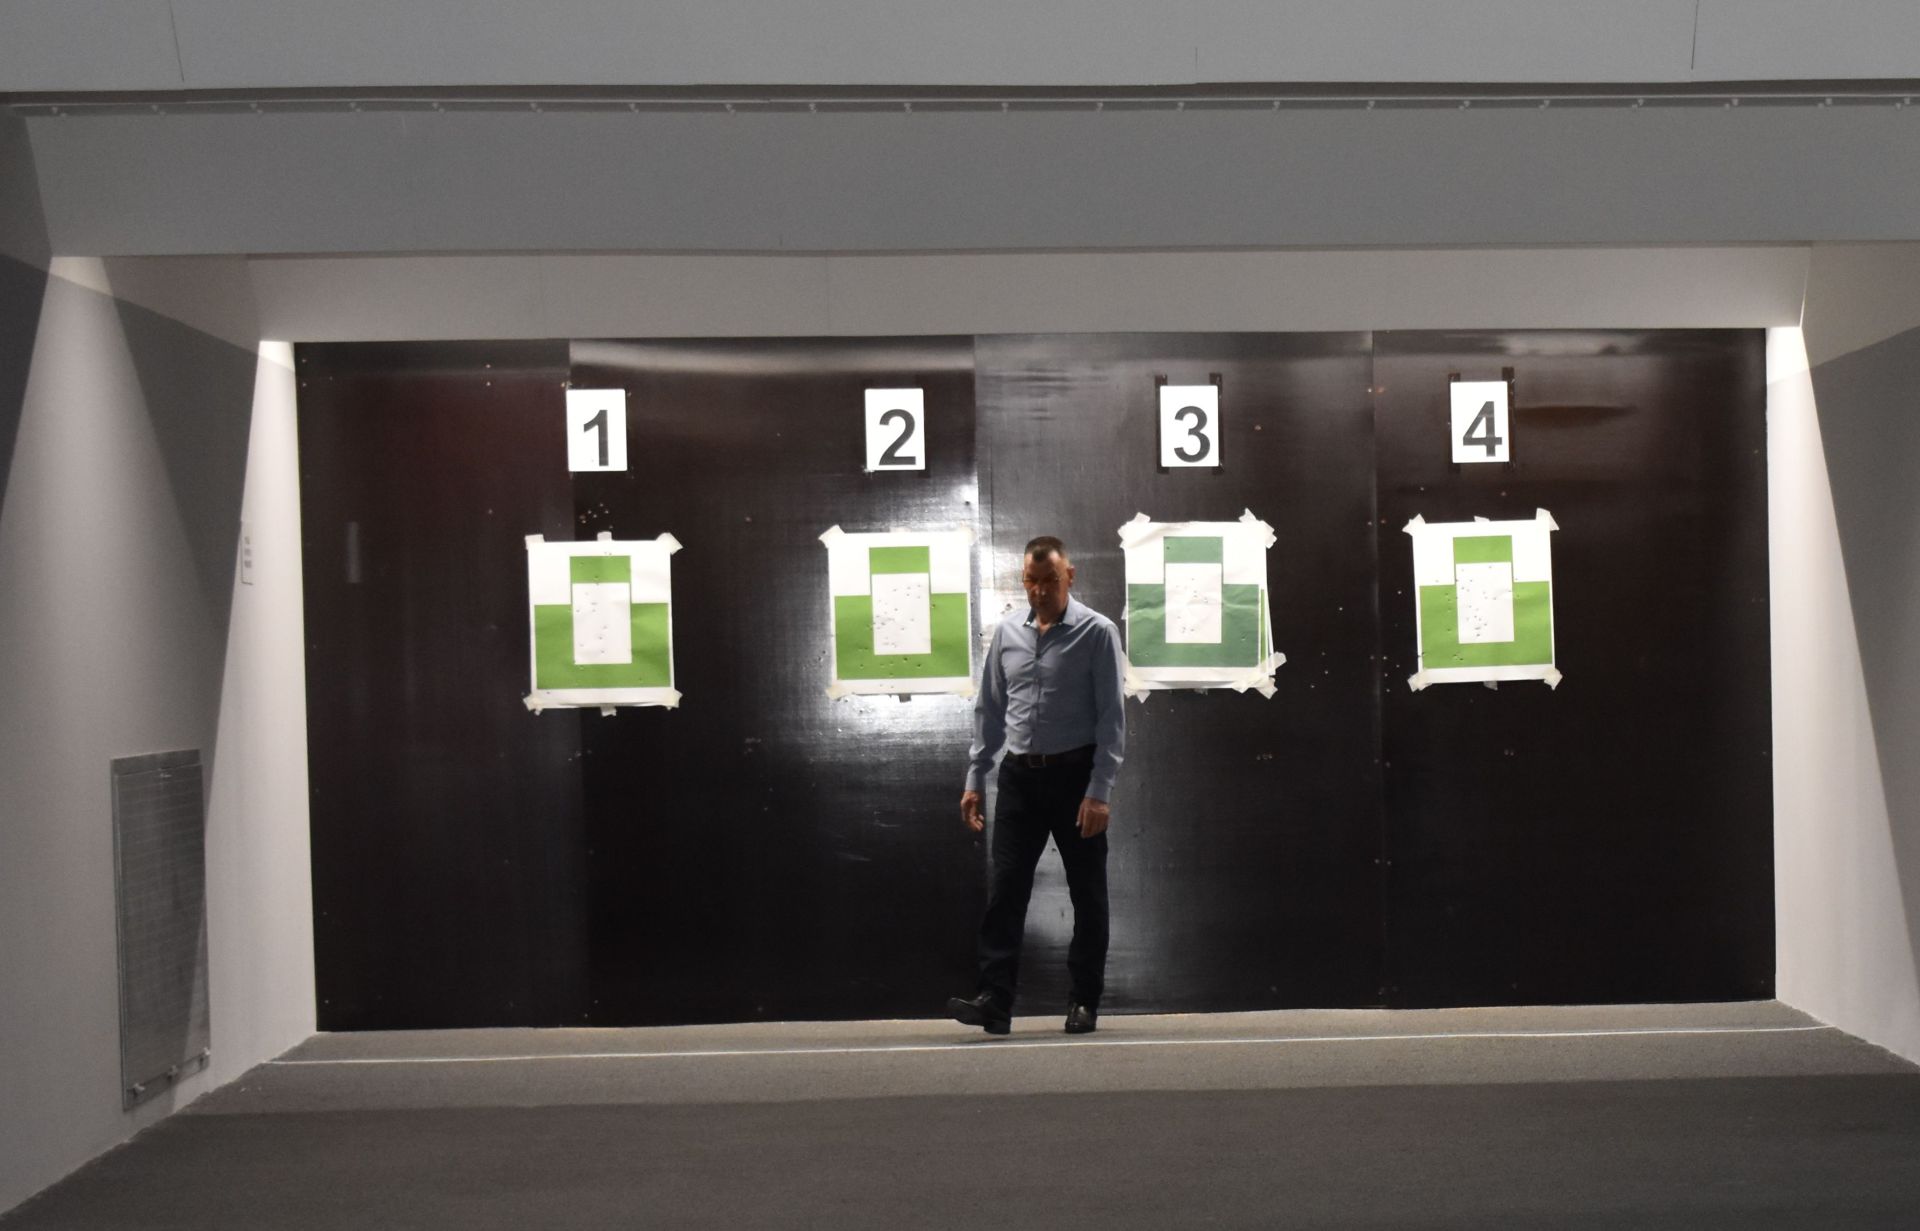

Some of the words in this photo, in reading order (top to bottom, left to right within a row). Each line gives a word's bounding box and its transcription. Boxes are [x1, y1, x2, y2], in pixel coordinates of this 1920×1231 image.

[583, 409, 609, 467] 1
[878, 409, 916, 466] 2
[1173, 406, 1211, 463] 3
[1462, 401, 1503, 457] 4
